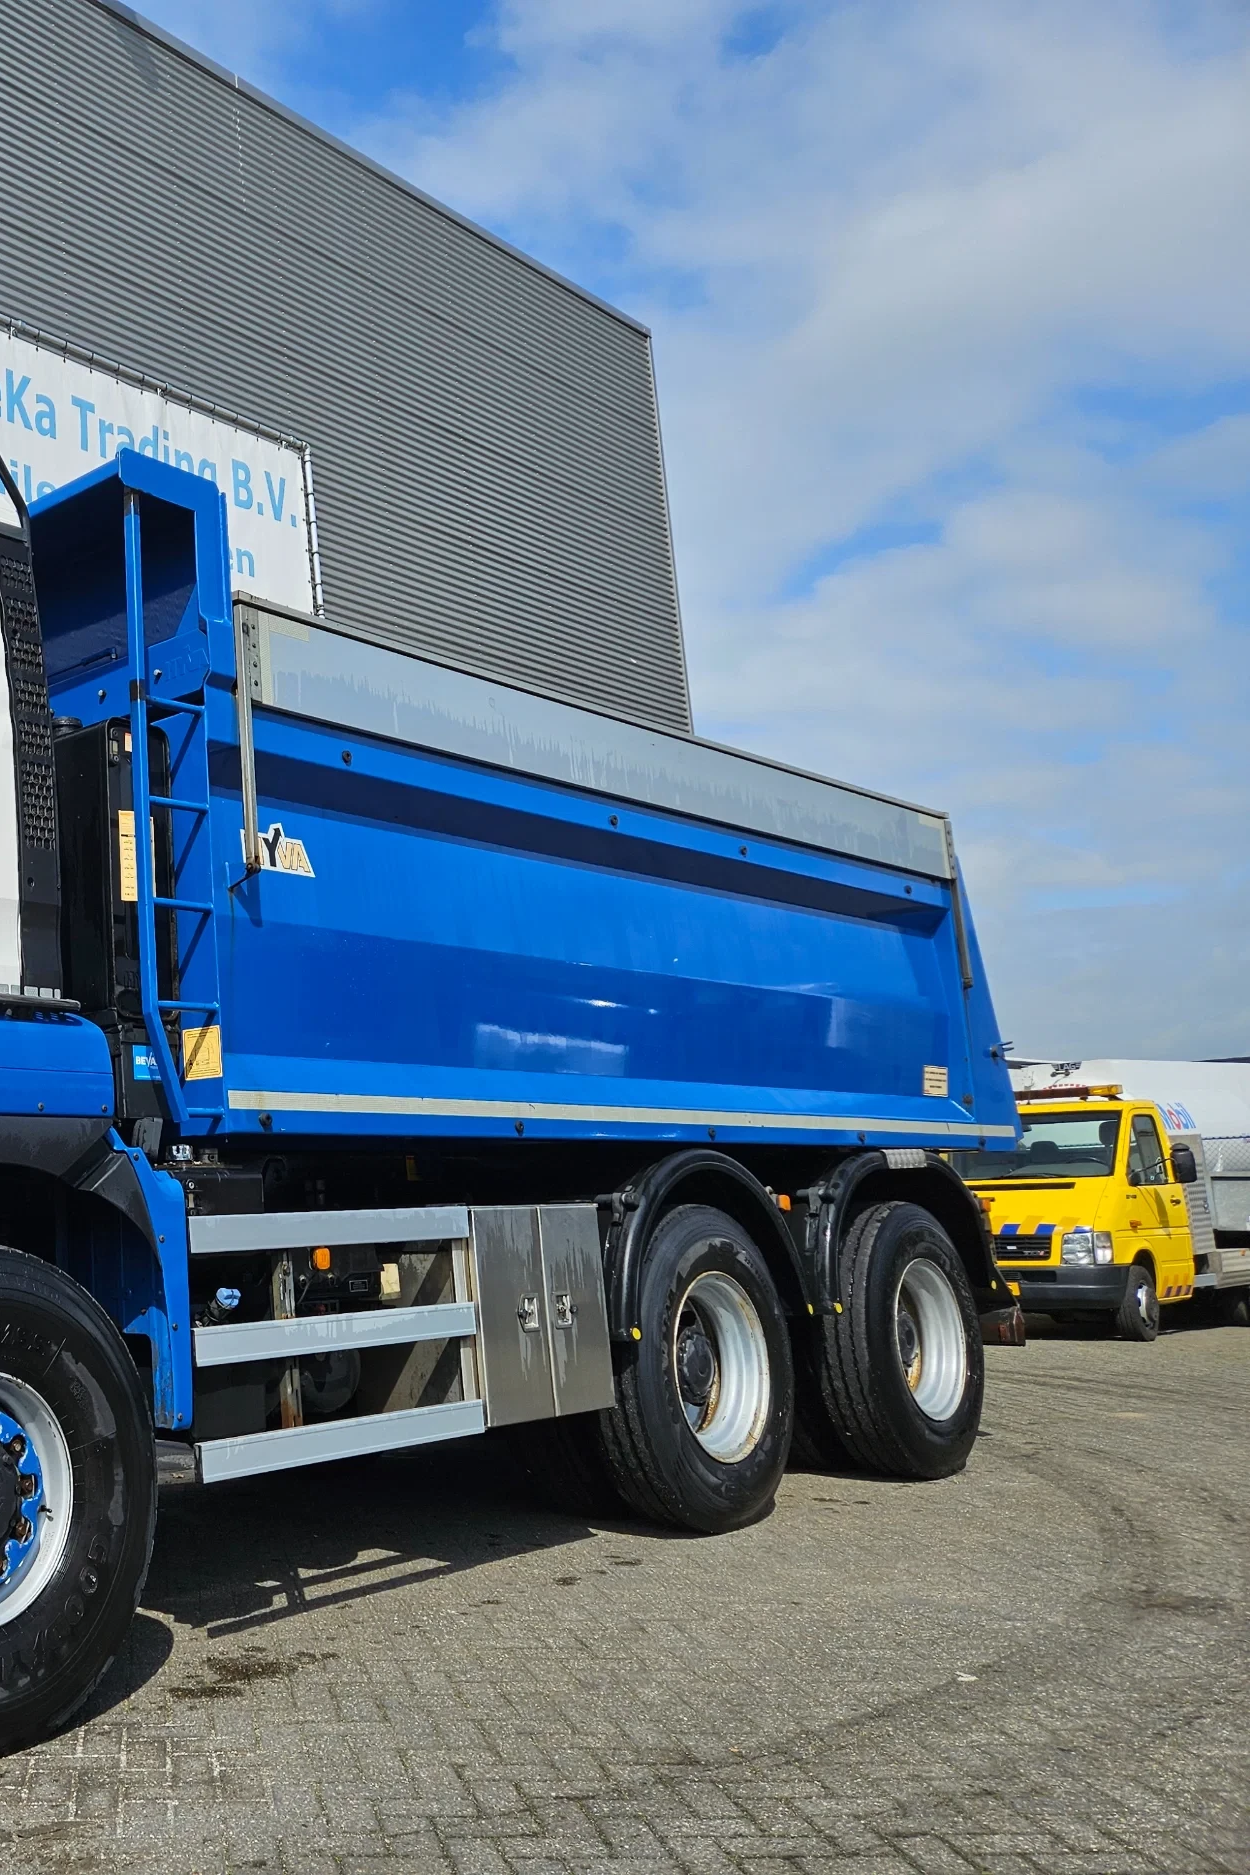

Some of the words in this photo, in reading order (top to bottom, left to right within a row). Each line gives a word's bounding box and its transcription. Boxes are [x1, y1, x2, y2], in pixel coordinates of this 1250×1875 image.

[71, 394, 218, 484] Trading
[231, 458, 297, 528] B.V.
[244, 827, 312, 873] YVA
[1058, 1062, 1077, 1071] LAG
[1156, 1102, 1197, 1131] Mobil
